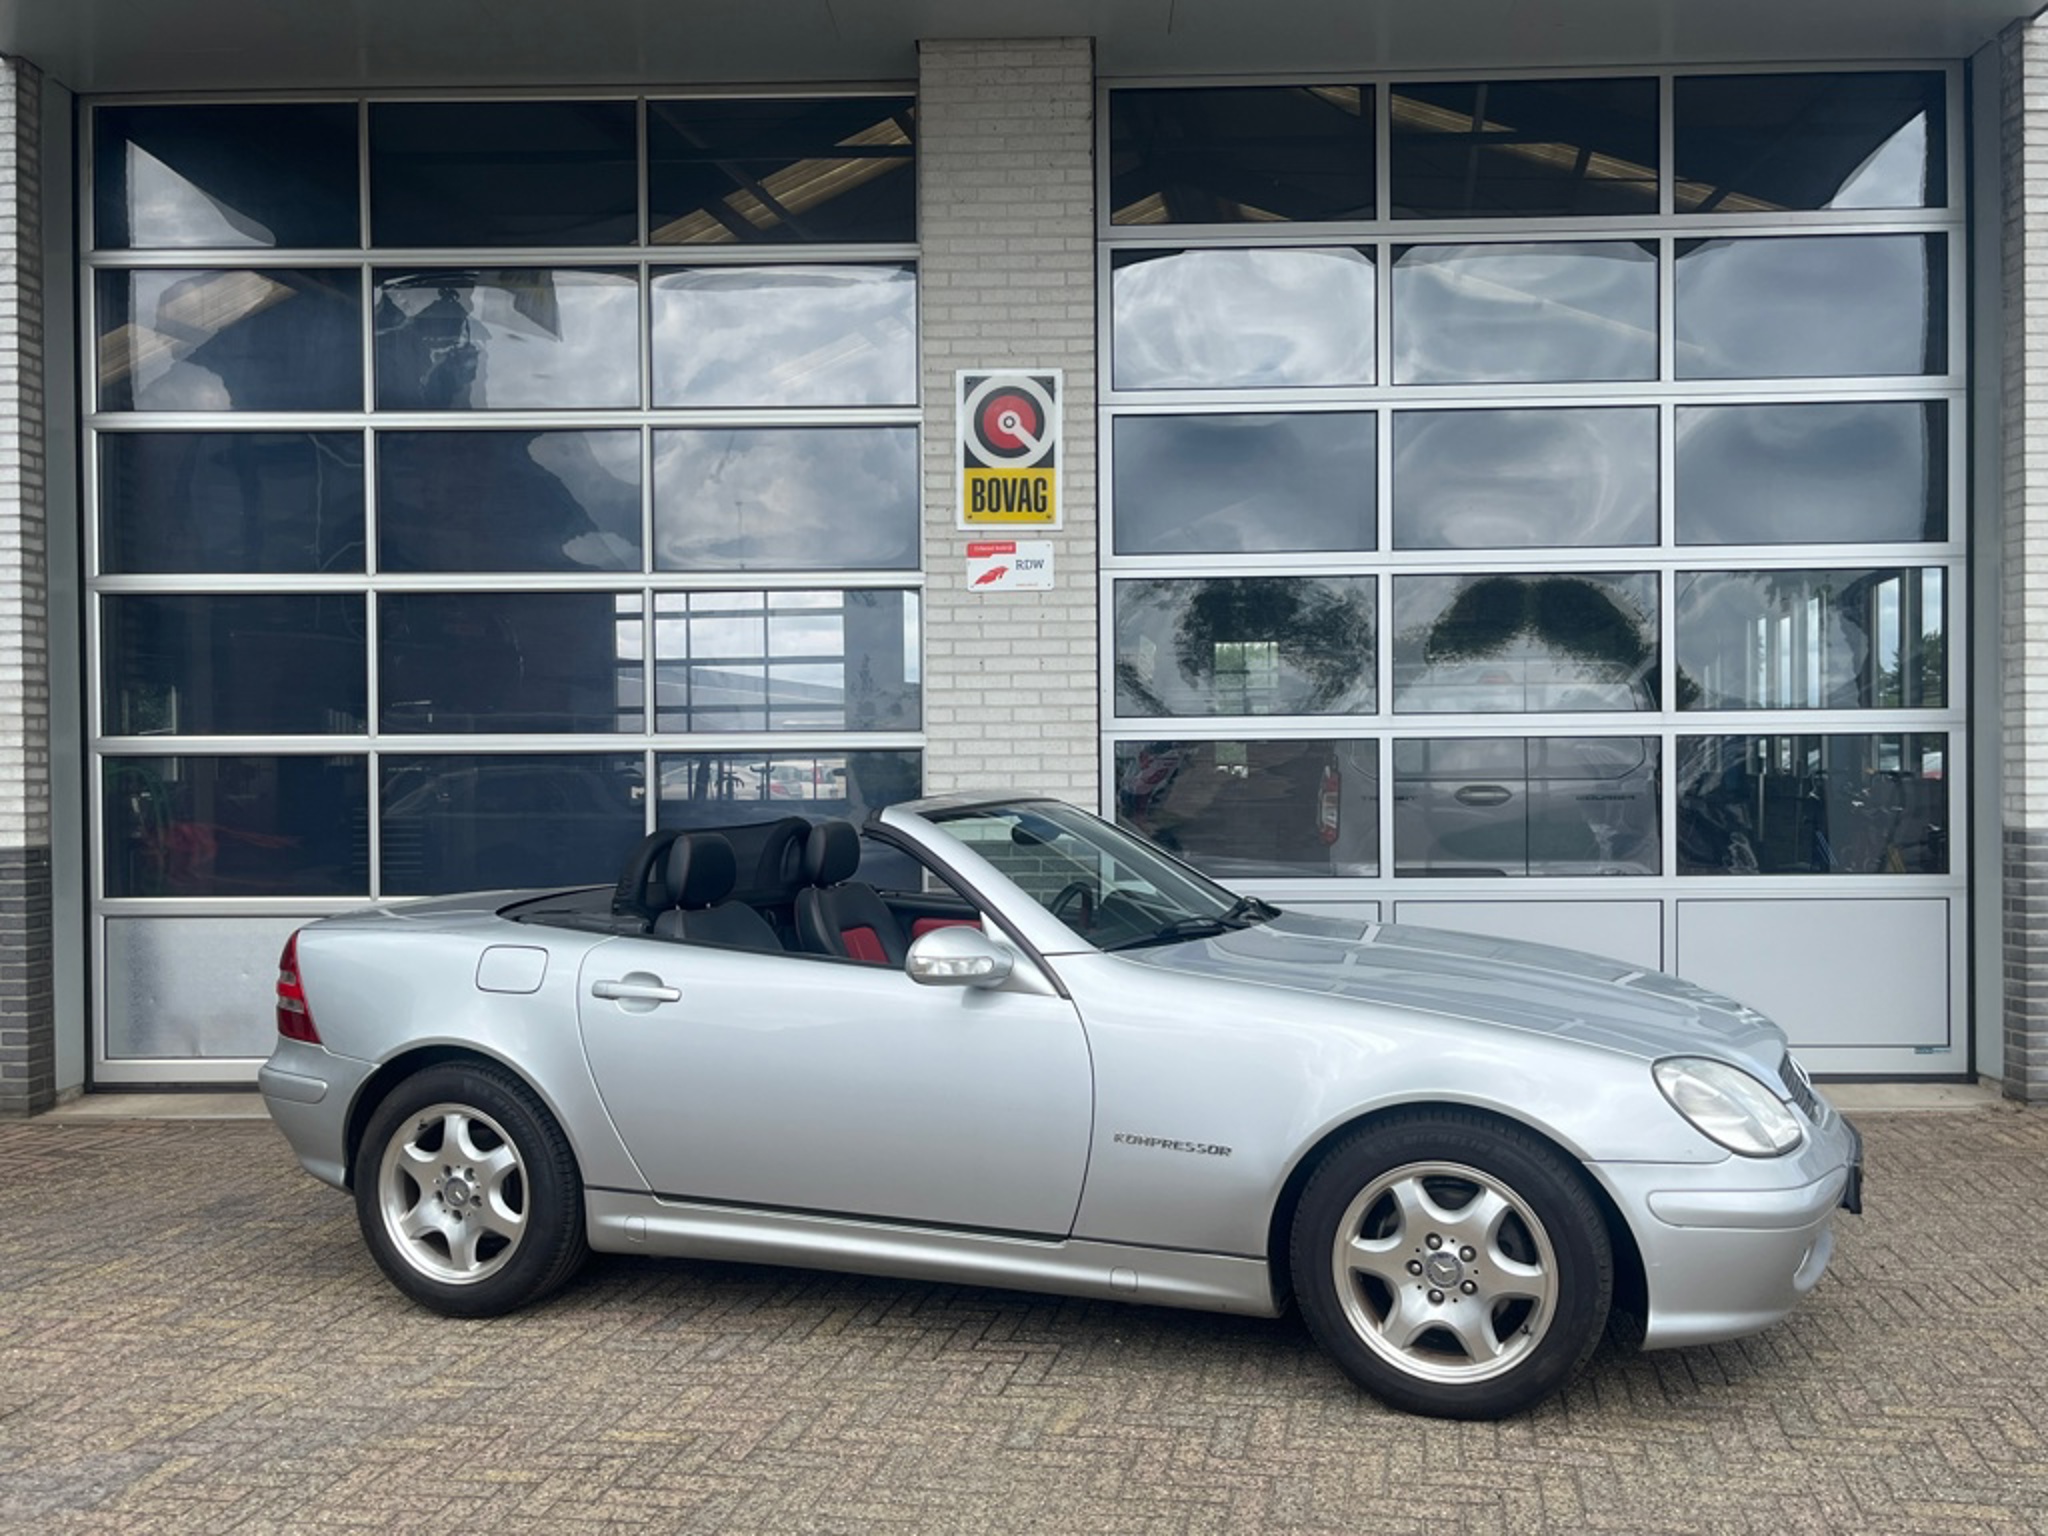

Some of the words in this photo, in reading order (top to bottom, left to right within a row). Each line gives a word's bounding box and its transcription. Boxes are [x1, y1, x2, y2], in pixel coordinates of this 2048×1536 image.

[972, 477, 1048, 513] BOVAG
[1015, 559, 1044, 571] RDW
[1113, 1133, 1232, 1157] KOMPRESSOR
